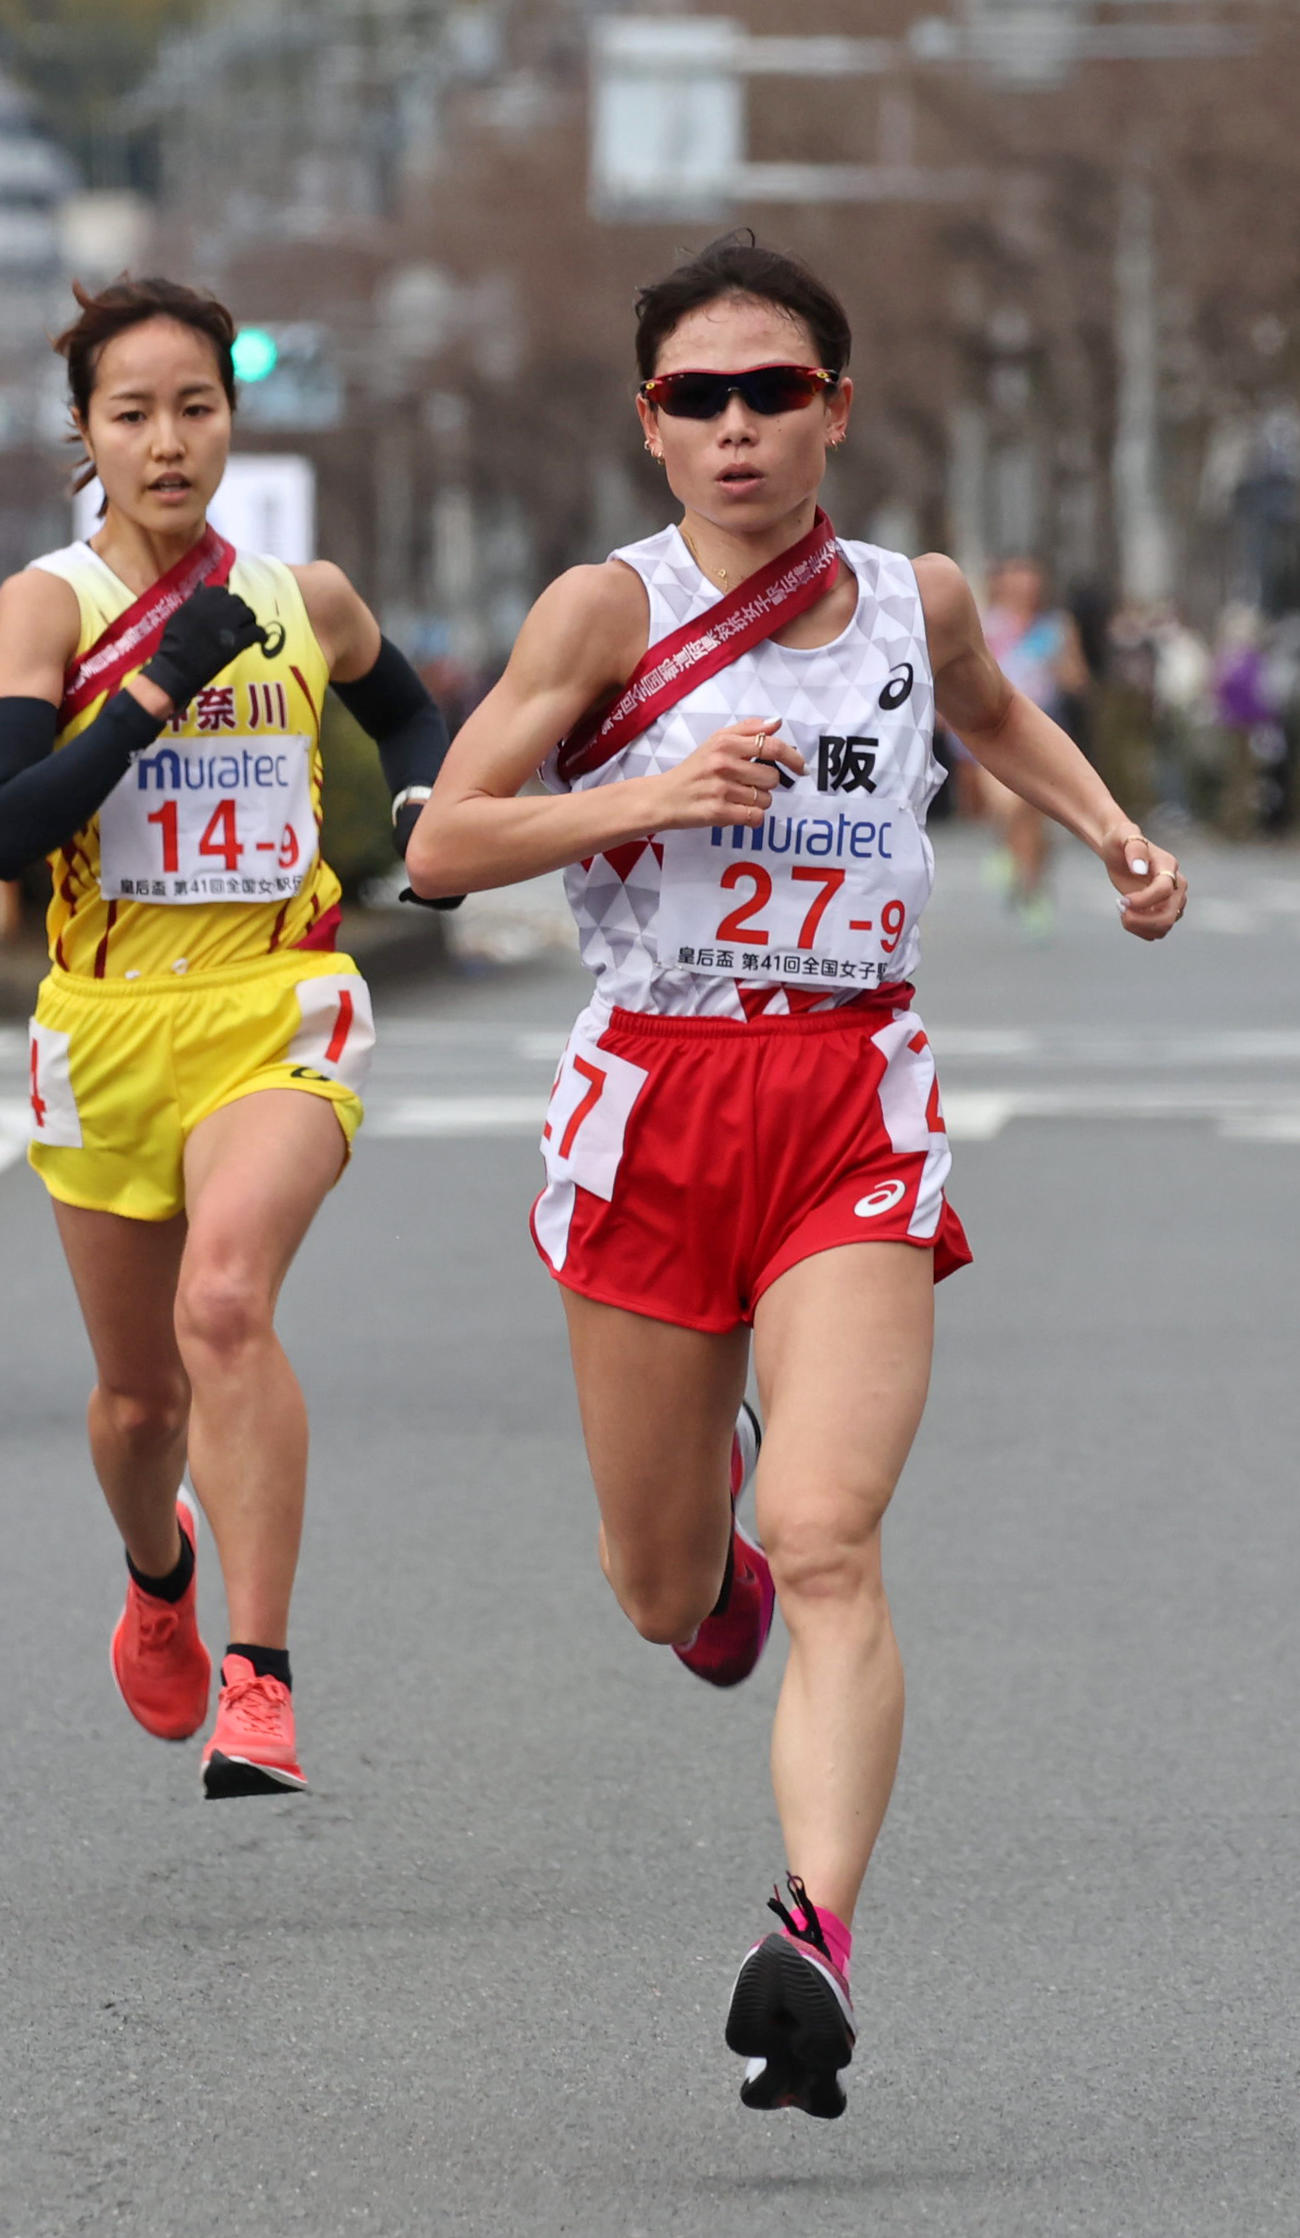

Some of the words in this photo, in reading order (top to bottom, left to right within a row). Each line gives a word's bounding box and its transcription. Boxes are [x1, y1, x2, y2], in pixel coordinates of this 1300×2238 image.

[138, 748, 288, 790] muratec
[677, 946, 735, 969] 皇后盃
[543, 1053, 607, 1160] 7
